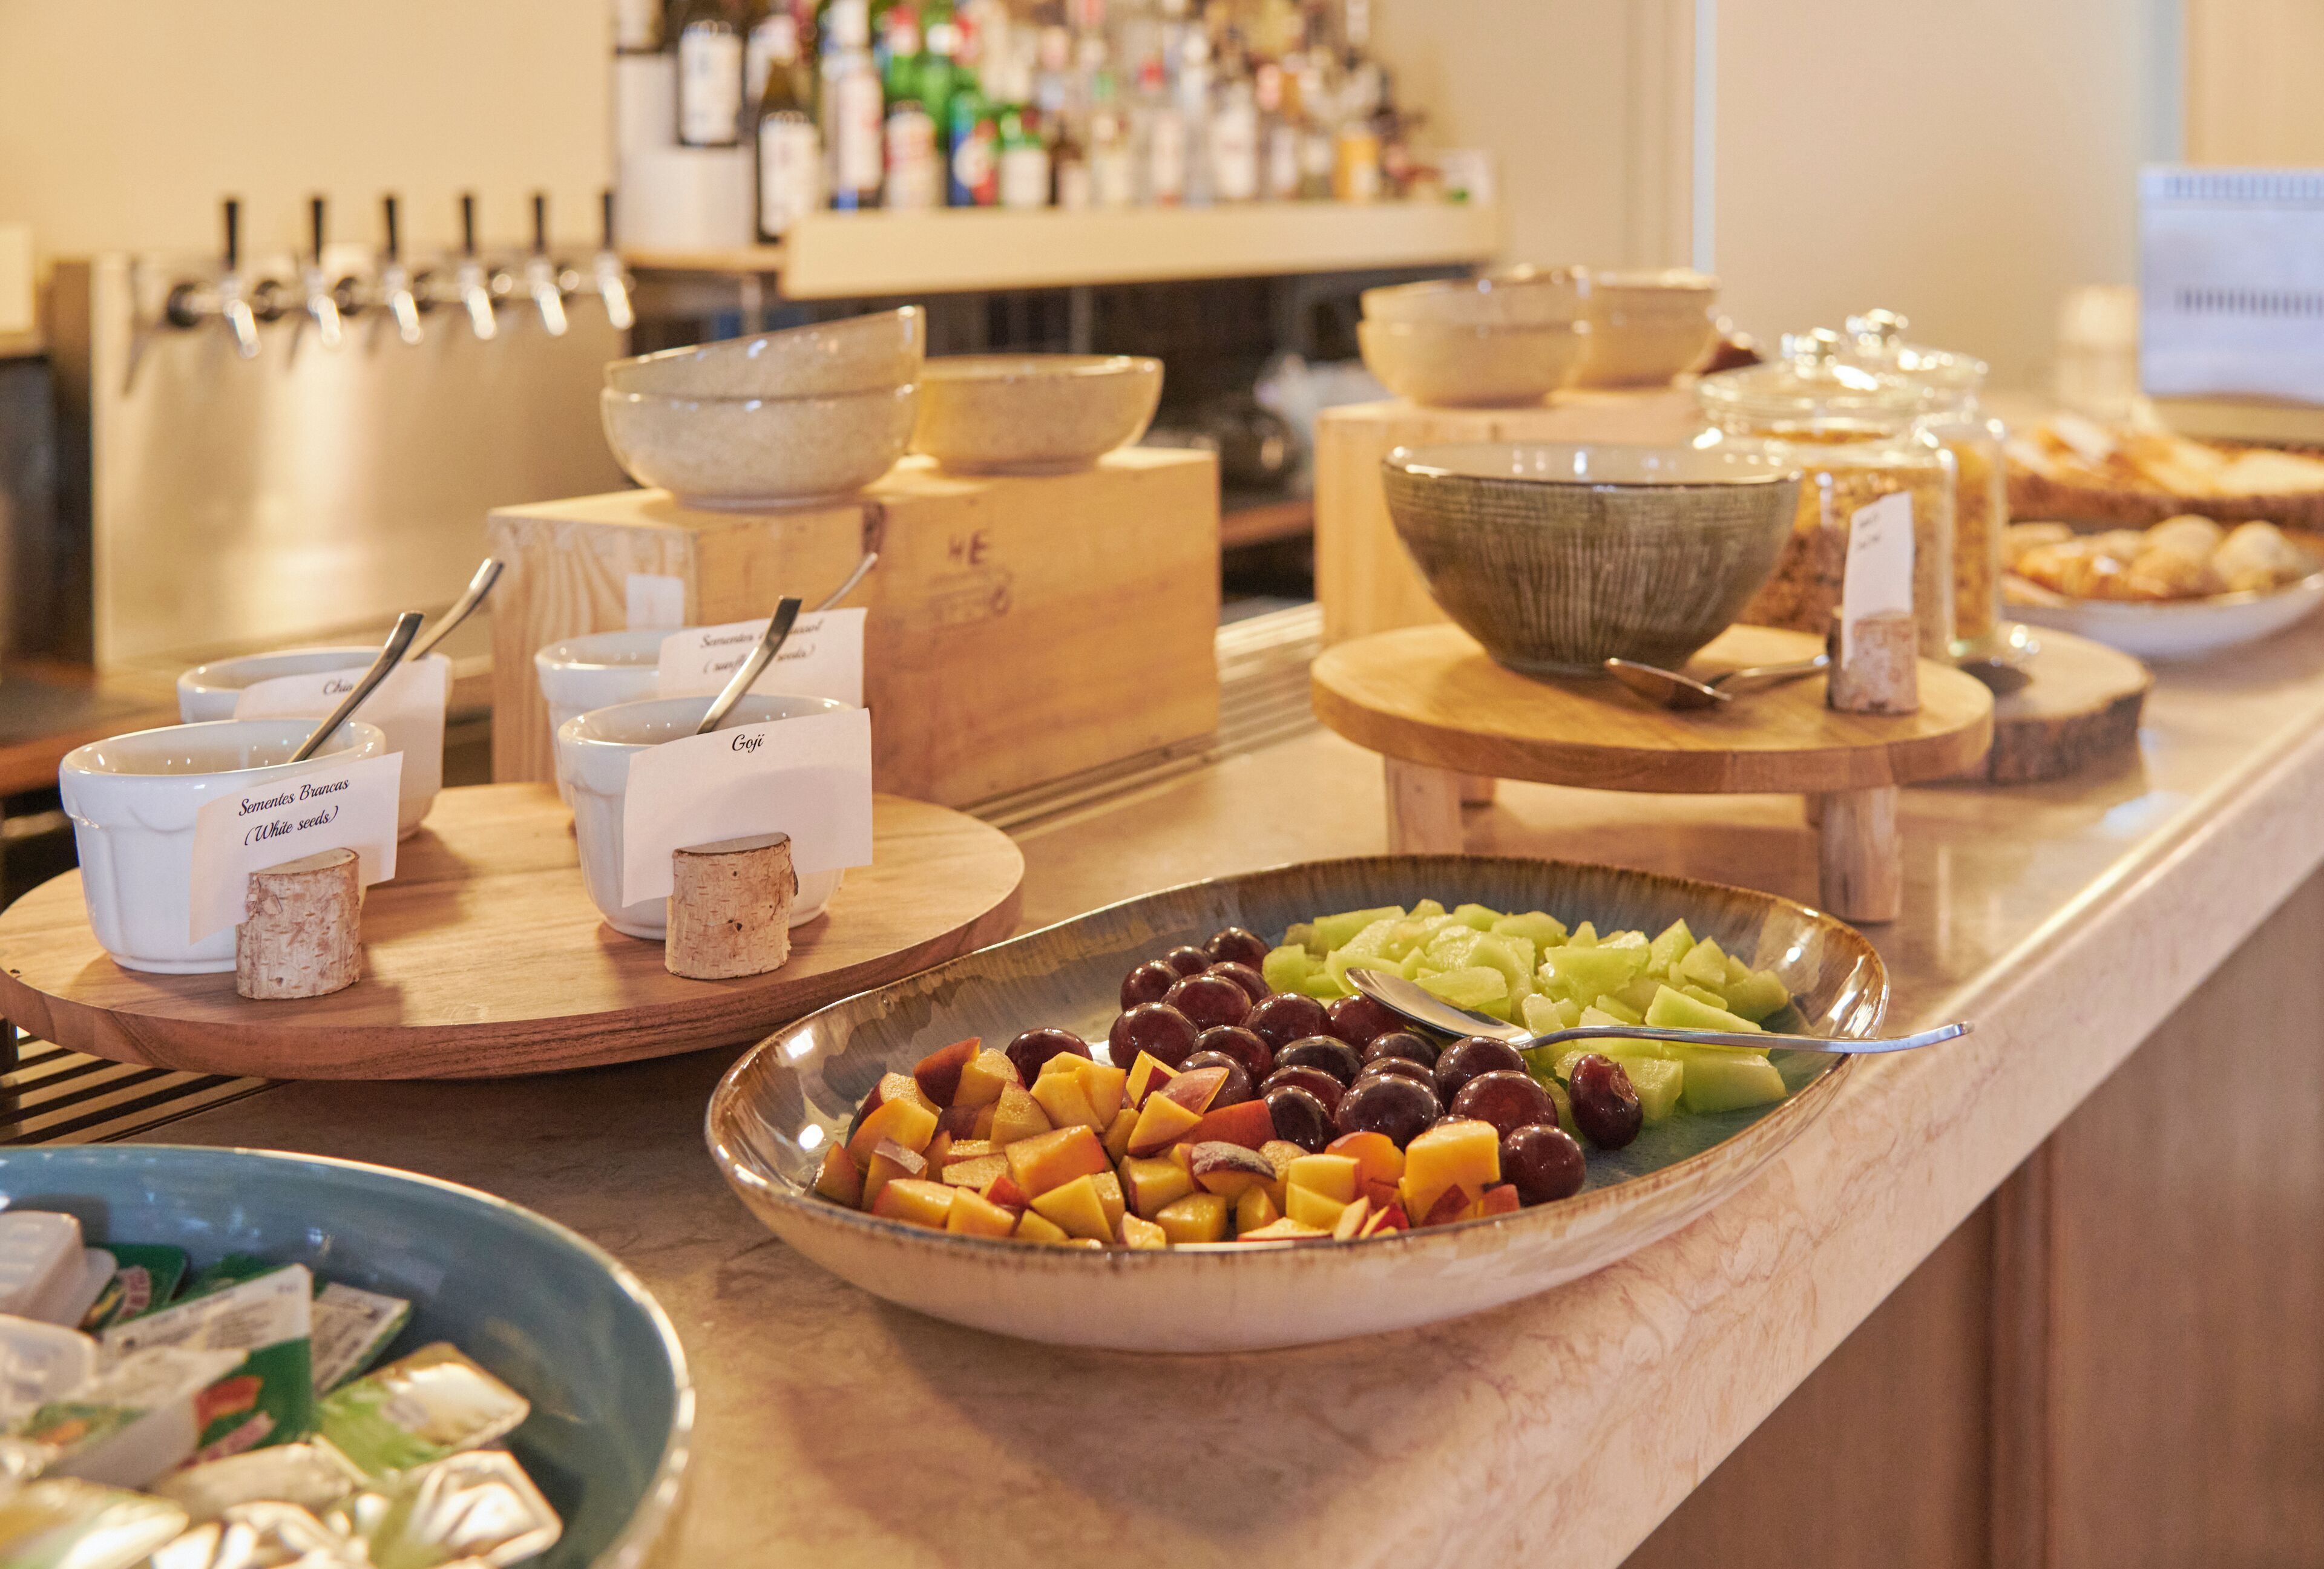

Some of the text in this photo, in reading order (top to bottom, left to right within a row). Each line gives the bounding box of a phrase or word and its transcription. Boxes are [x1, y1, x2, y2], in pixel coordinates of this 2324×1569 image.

[732, 733, 765, 753] Goji
[238, 779, 350, 816] Sementes Brancas
[244, 805, 339, 846] (White seeds)
